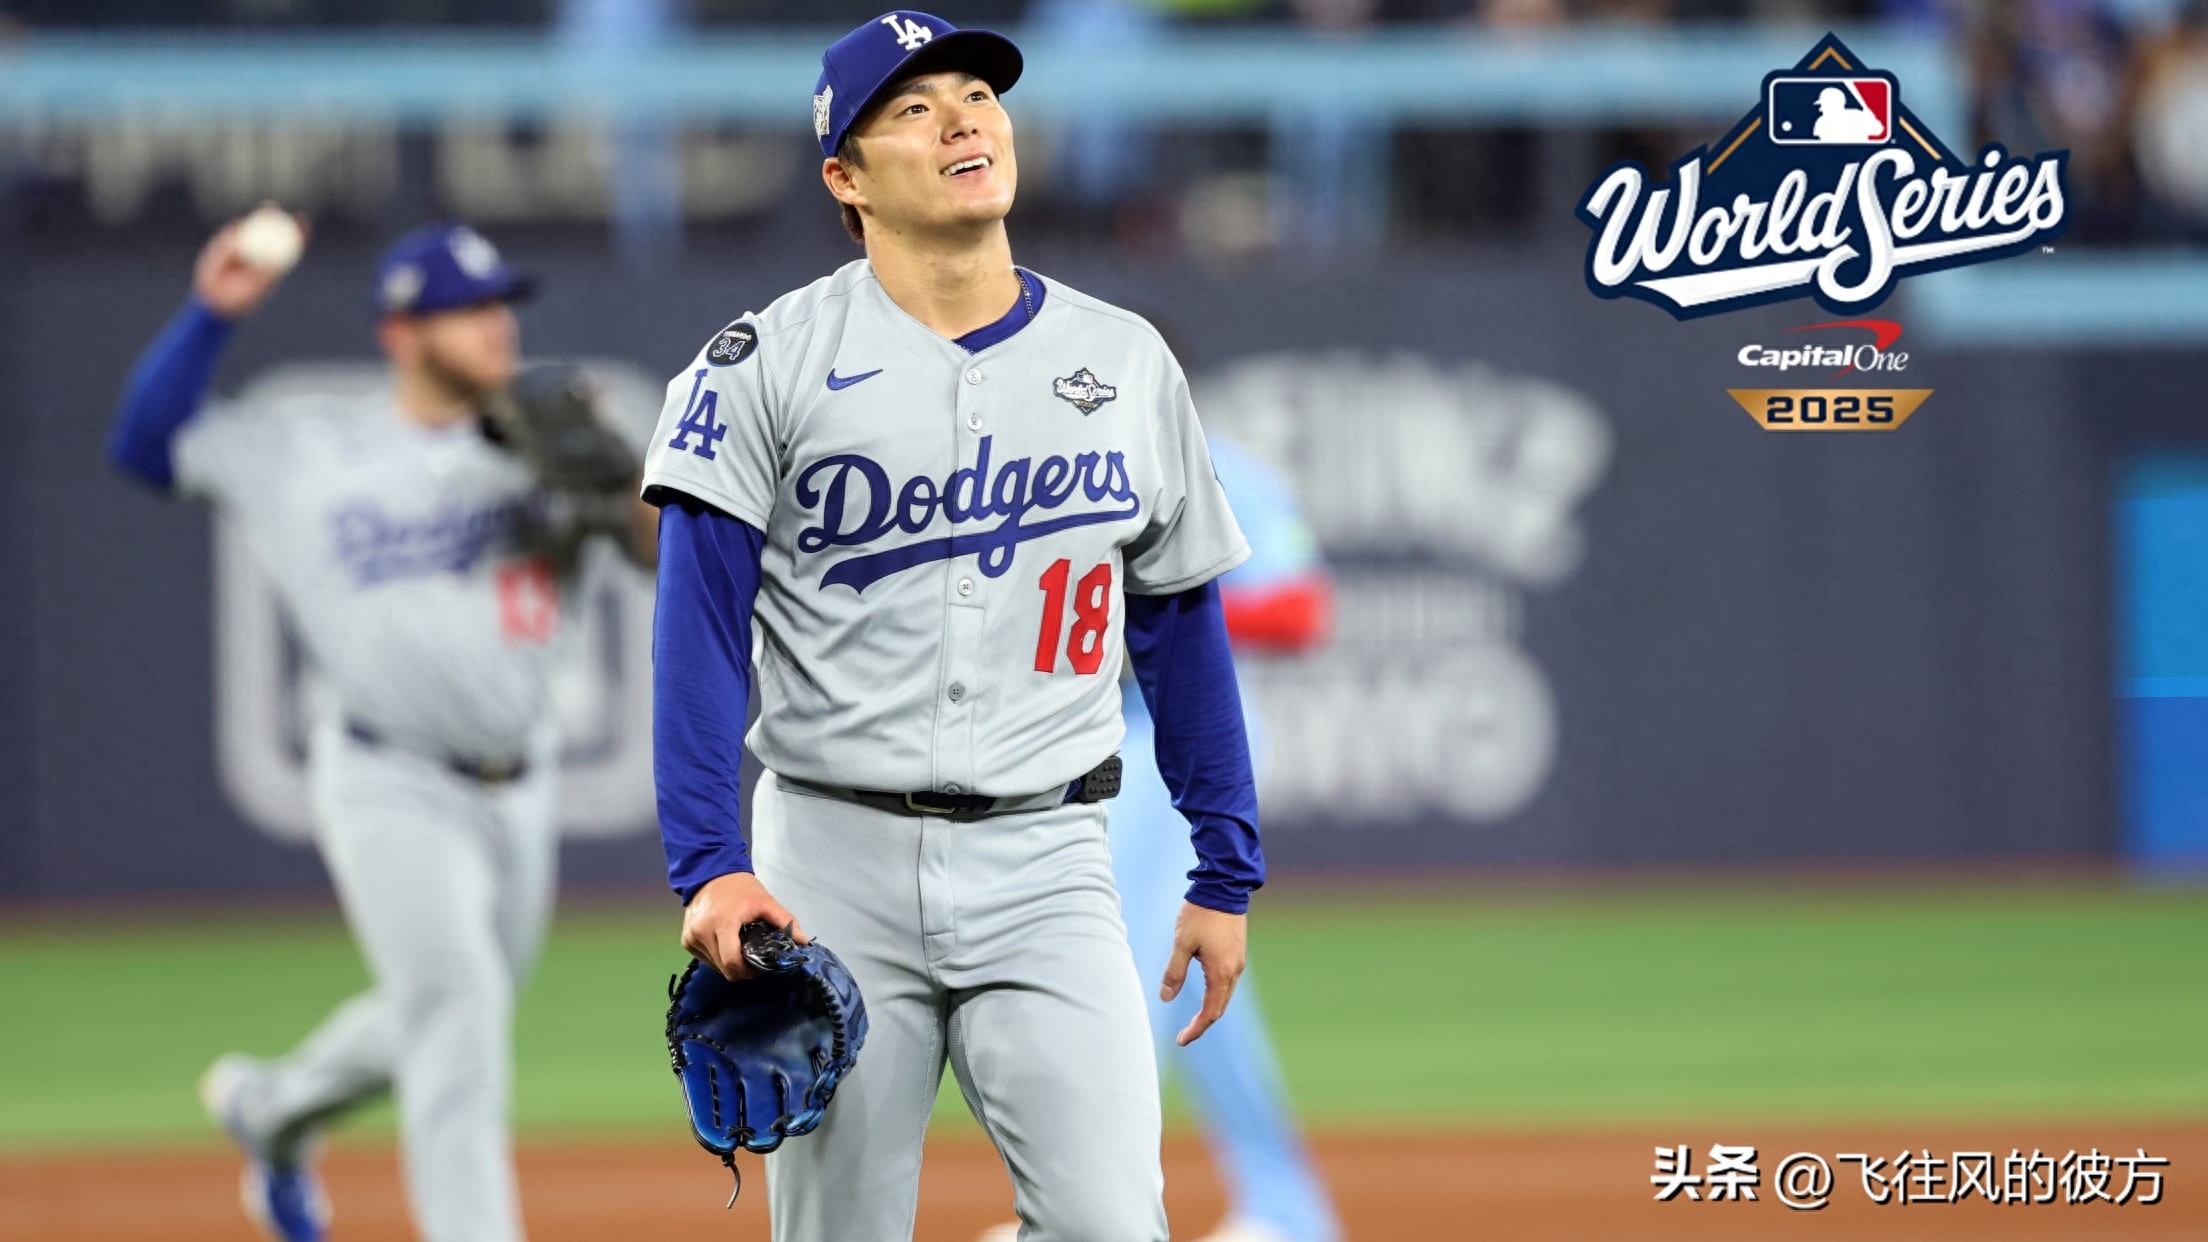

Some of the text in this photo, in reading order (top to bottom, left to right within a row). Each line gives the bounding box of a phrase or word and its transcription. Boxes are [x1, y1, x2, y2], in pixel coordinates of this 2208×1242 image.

[881, 14, 933, 51] LA
[712, 337, 746, 360] 34
[668, 368, 728, 461] LA
[796, 434, 1140, 594] Dodgers
[1033, 558, 1112, 675] 18
